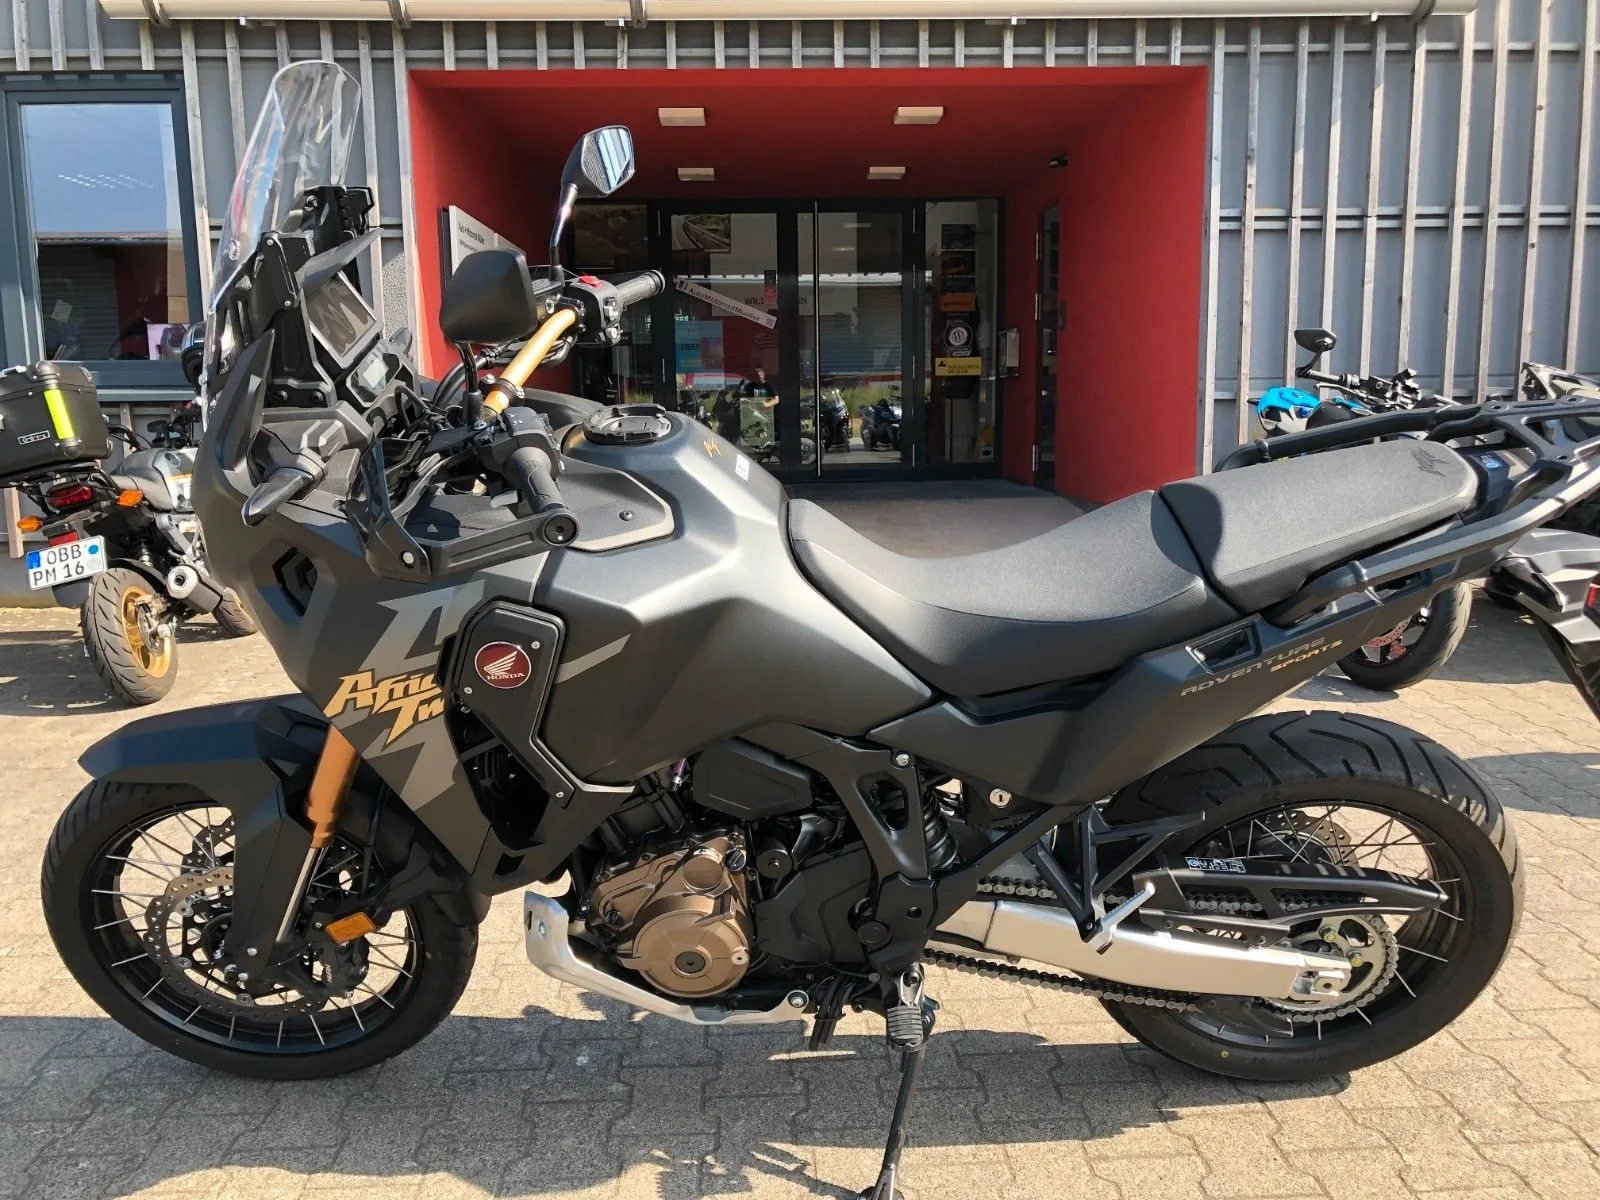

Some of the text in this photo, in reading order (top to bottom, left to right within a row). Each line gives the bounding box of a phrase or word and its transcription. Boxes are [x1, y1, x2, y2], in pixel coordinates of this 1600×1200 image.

[47, 544, 82, 565] OBB
[33, 560, 85, 586] PM 16
[1181, 637, 1326, 696] ADVENTURE
[1270, 639, 1343, 673] SPORTS
[486, 672, 526, 680] HONDA
[323, 671, 437, 718] Afric
